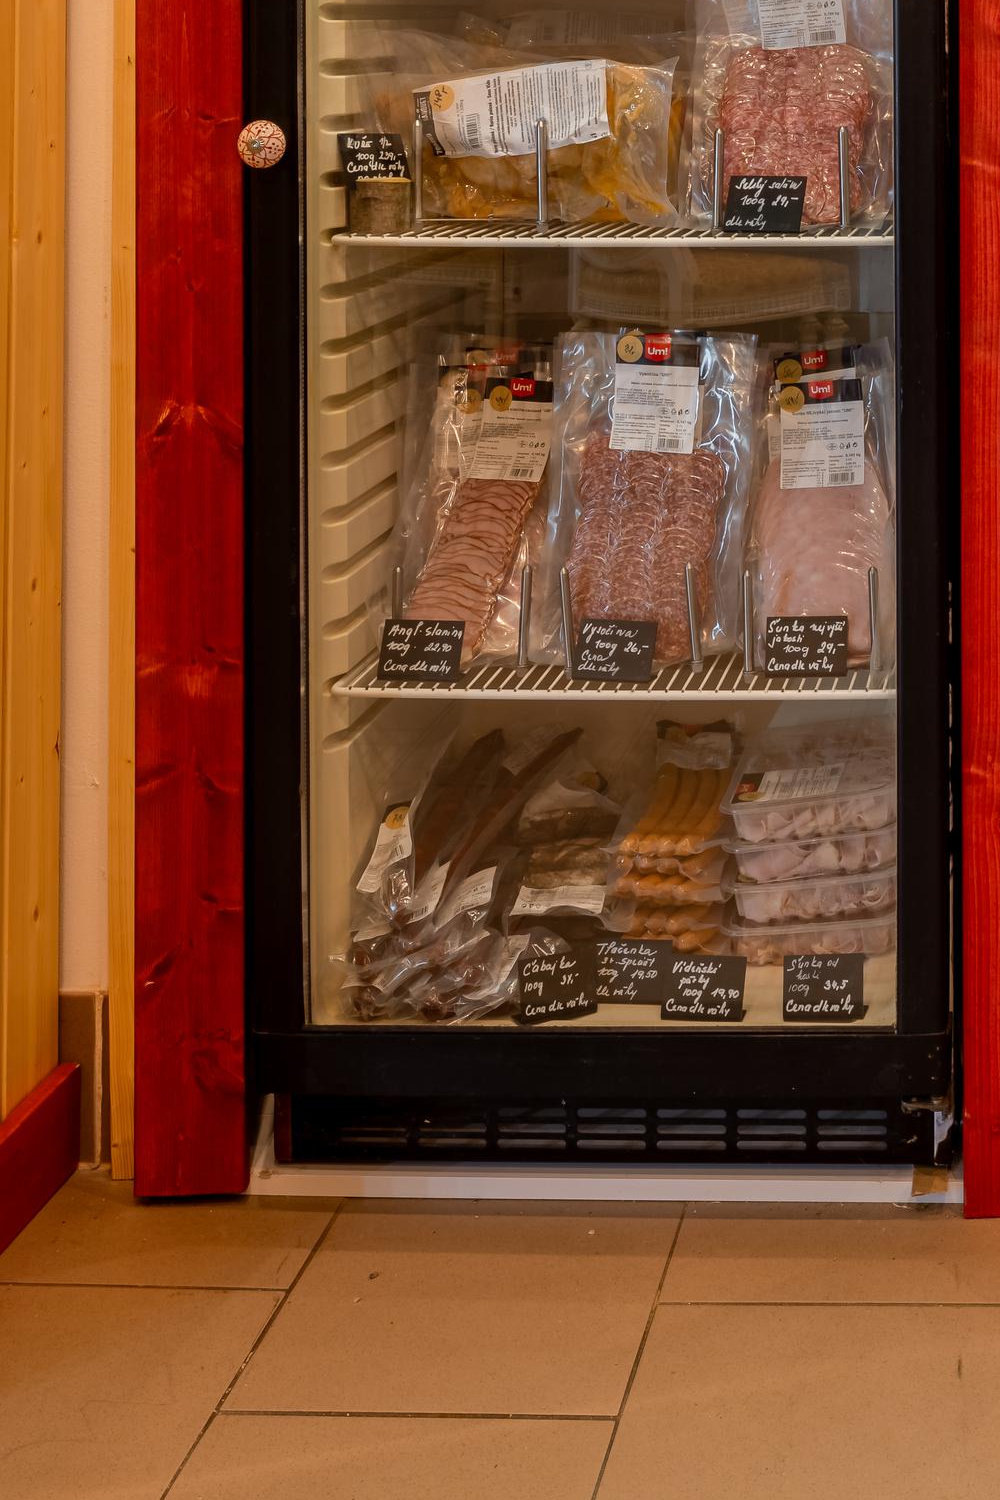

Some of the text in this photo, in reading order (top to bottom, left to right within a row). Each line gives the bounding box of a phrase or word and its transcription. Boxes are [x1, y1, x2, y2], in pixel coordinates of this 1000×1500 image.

[740, 194, 799, 212] 100g 29,-
[647, 346, 669, 356] Um!
[803, 355, 824, 365] Um!
[512, 382, 533, 392] Um!
[810, 385, 831, 394] Um!
[582, 622, 639, 644] Vysočina
[767, 618, 805, 634] Šunka
[423, 642, 452, 653] 22,90
[594, 639, 649, 657] 100g 26,-
[782, 641, 846, 658] 100g 29,-
[581, 649, 610, 662] Cena
[383, 659, 409, 672] Cena
[767, 657, 790, 672] Cena
[596, 941, 658, 956] Tlačenka
[826, 957, 840, 969] od
[630, 969, 658, 980] 19,50
[524, 980, 544, 996] 100g
[788, 983, 810, 997] 100g
[682, 987, 740, 1004] 100g 19,90
[525, 1004, 546, 1017] Cena
[665, 998, 688, 1012] Cena
[785, 998, 812, 1013] Cena
